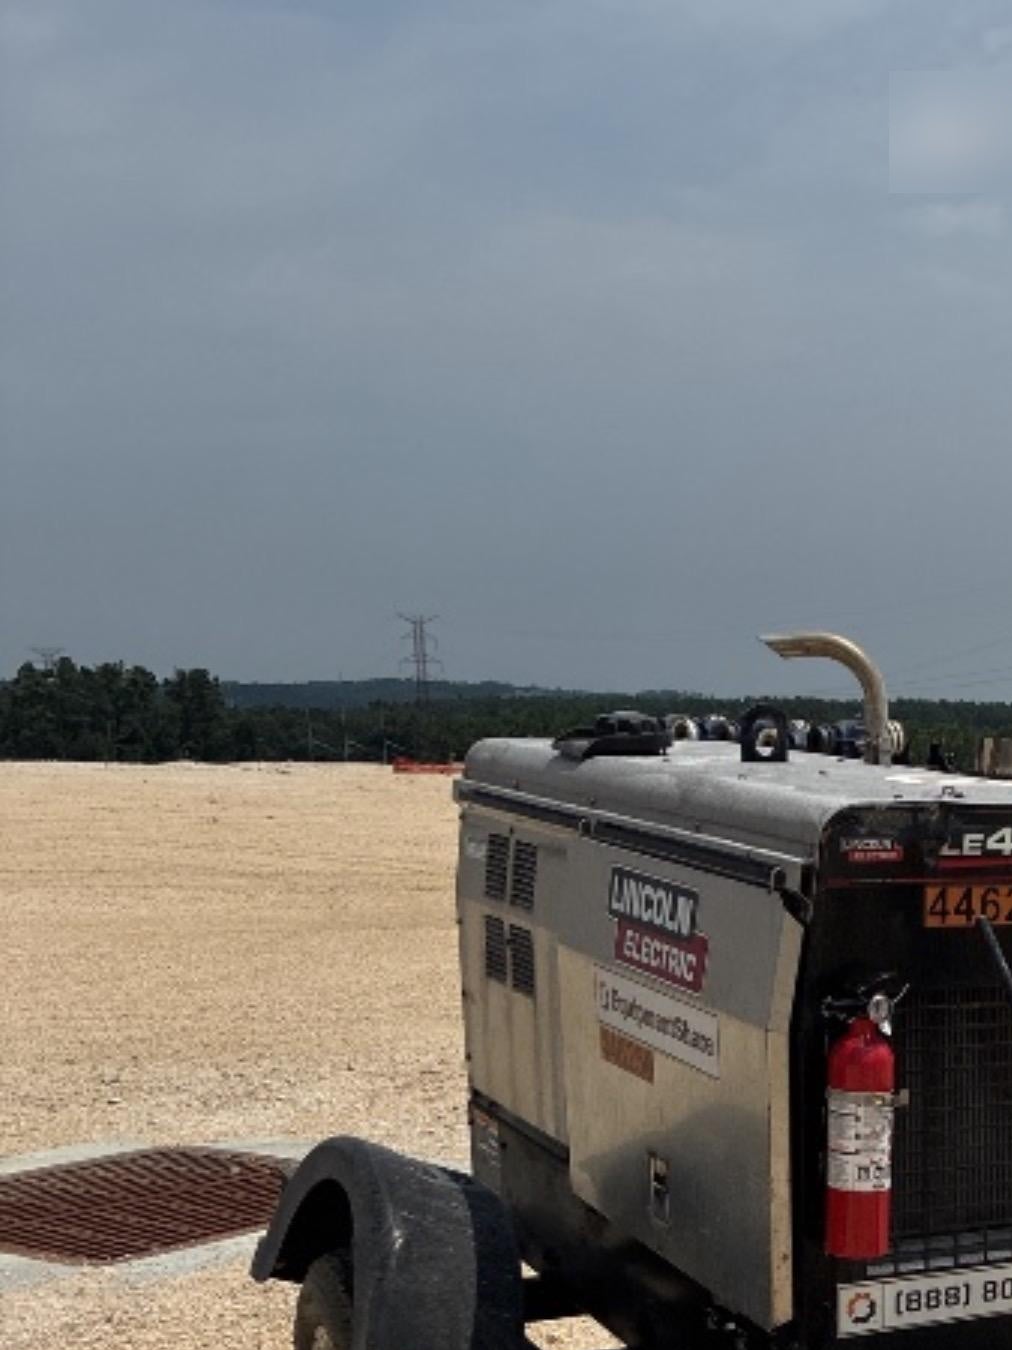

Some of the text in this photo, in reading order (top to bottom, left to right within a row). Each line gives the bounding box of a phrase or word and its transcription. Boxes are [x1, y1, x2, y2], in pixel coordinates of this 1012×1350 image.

[611, 874, 694, 937] LINCOLN
[624, 929, 697, 982] ELECTRIC
[896, 1284, 970, 1315] (888)
